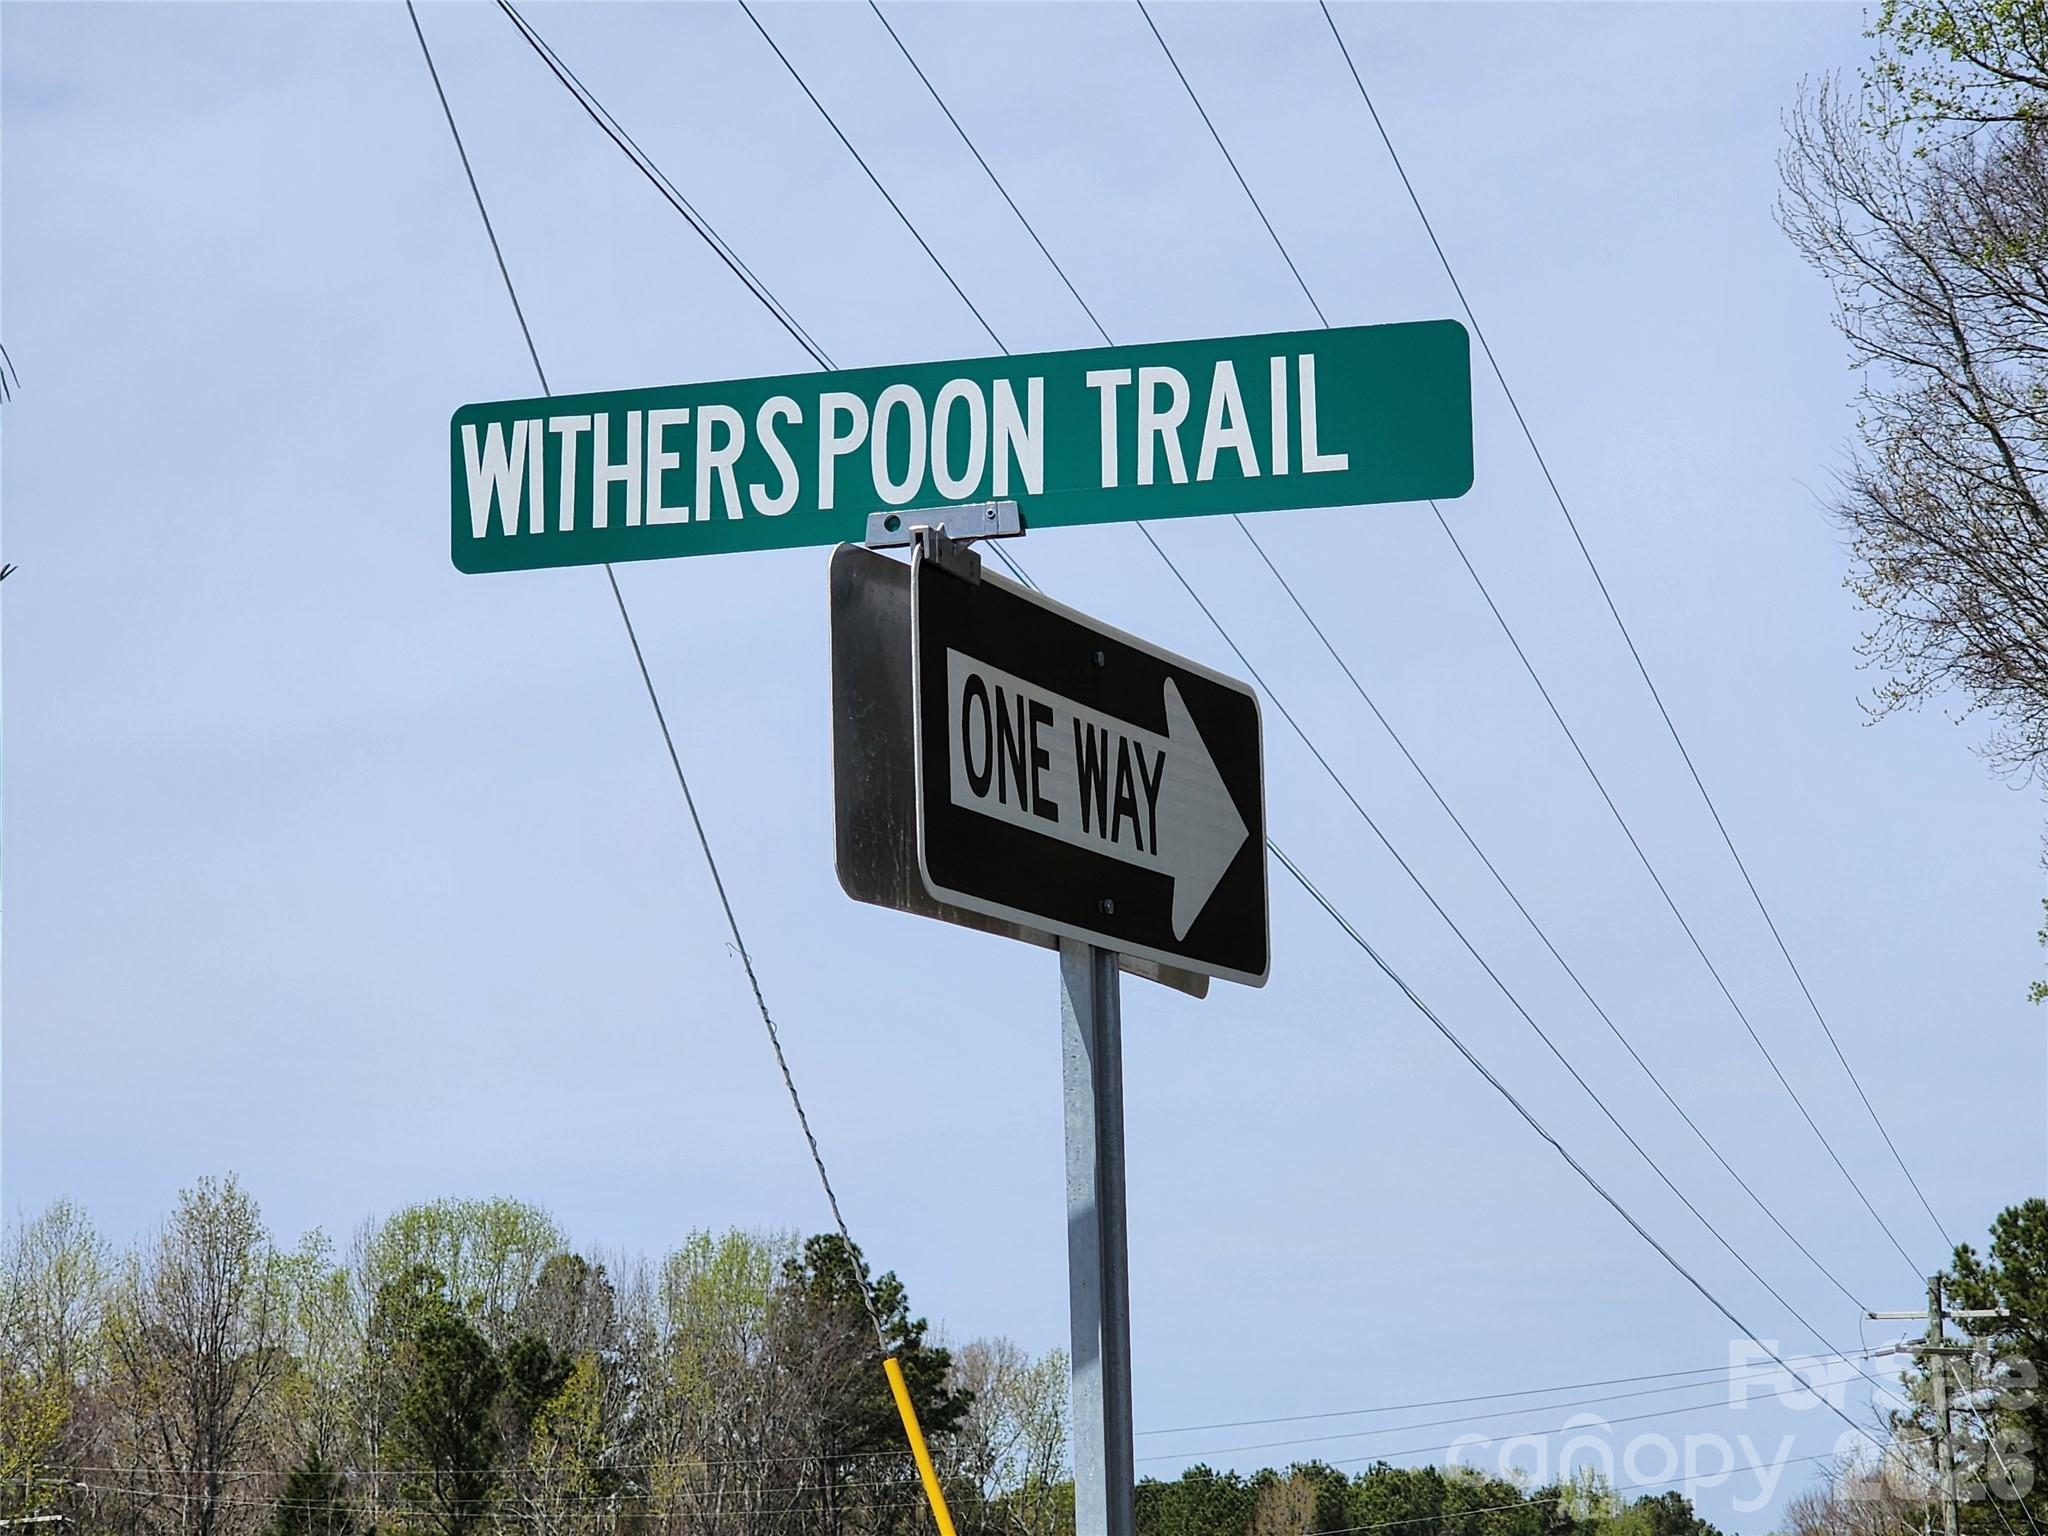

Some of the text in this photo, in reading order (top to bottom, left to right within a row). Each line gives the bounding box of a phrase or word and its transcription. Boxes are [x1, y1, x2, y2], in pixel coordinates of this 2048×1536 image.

[461, 353, 1349, 539] WITHERSPOON TRAIL
[961, 673, 1167, 857] ONE WAY
